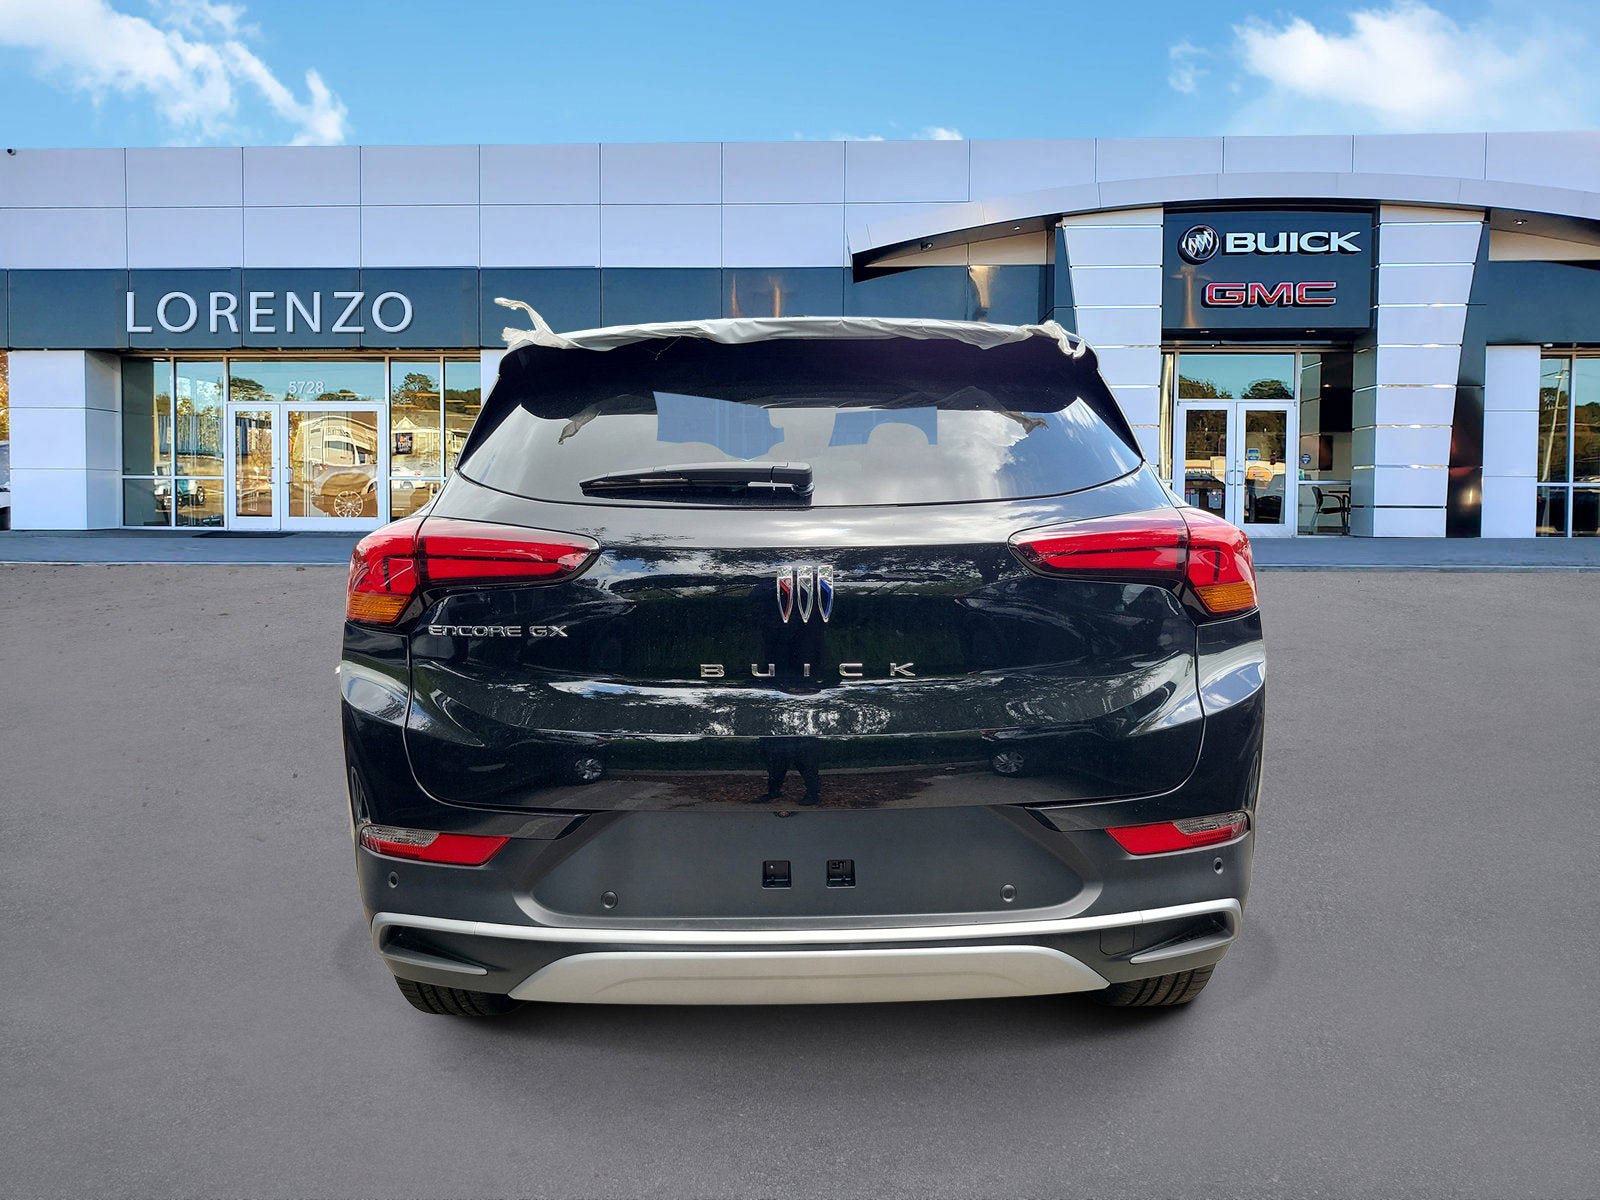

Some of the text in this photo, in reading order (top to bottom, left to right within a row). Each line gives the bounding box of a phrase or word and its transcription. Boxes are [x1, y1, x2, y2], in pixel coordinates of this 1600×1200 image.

[1225, 231, 1362, 253] BUICK
[1205, 281, 1337, 306] GMC
[126, 291, 413, 333] LORENZO
[288, 380, 325, 395] 5728
[428, 625, 568, 637] ENCORE GX
[700, 663, 916, 677] BUICK
